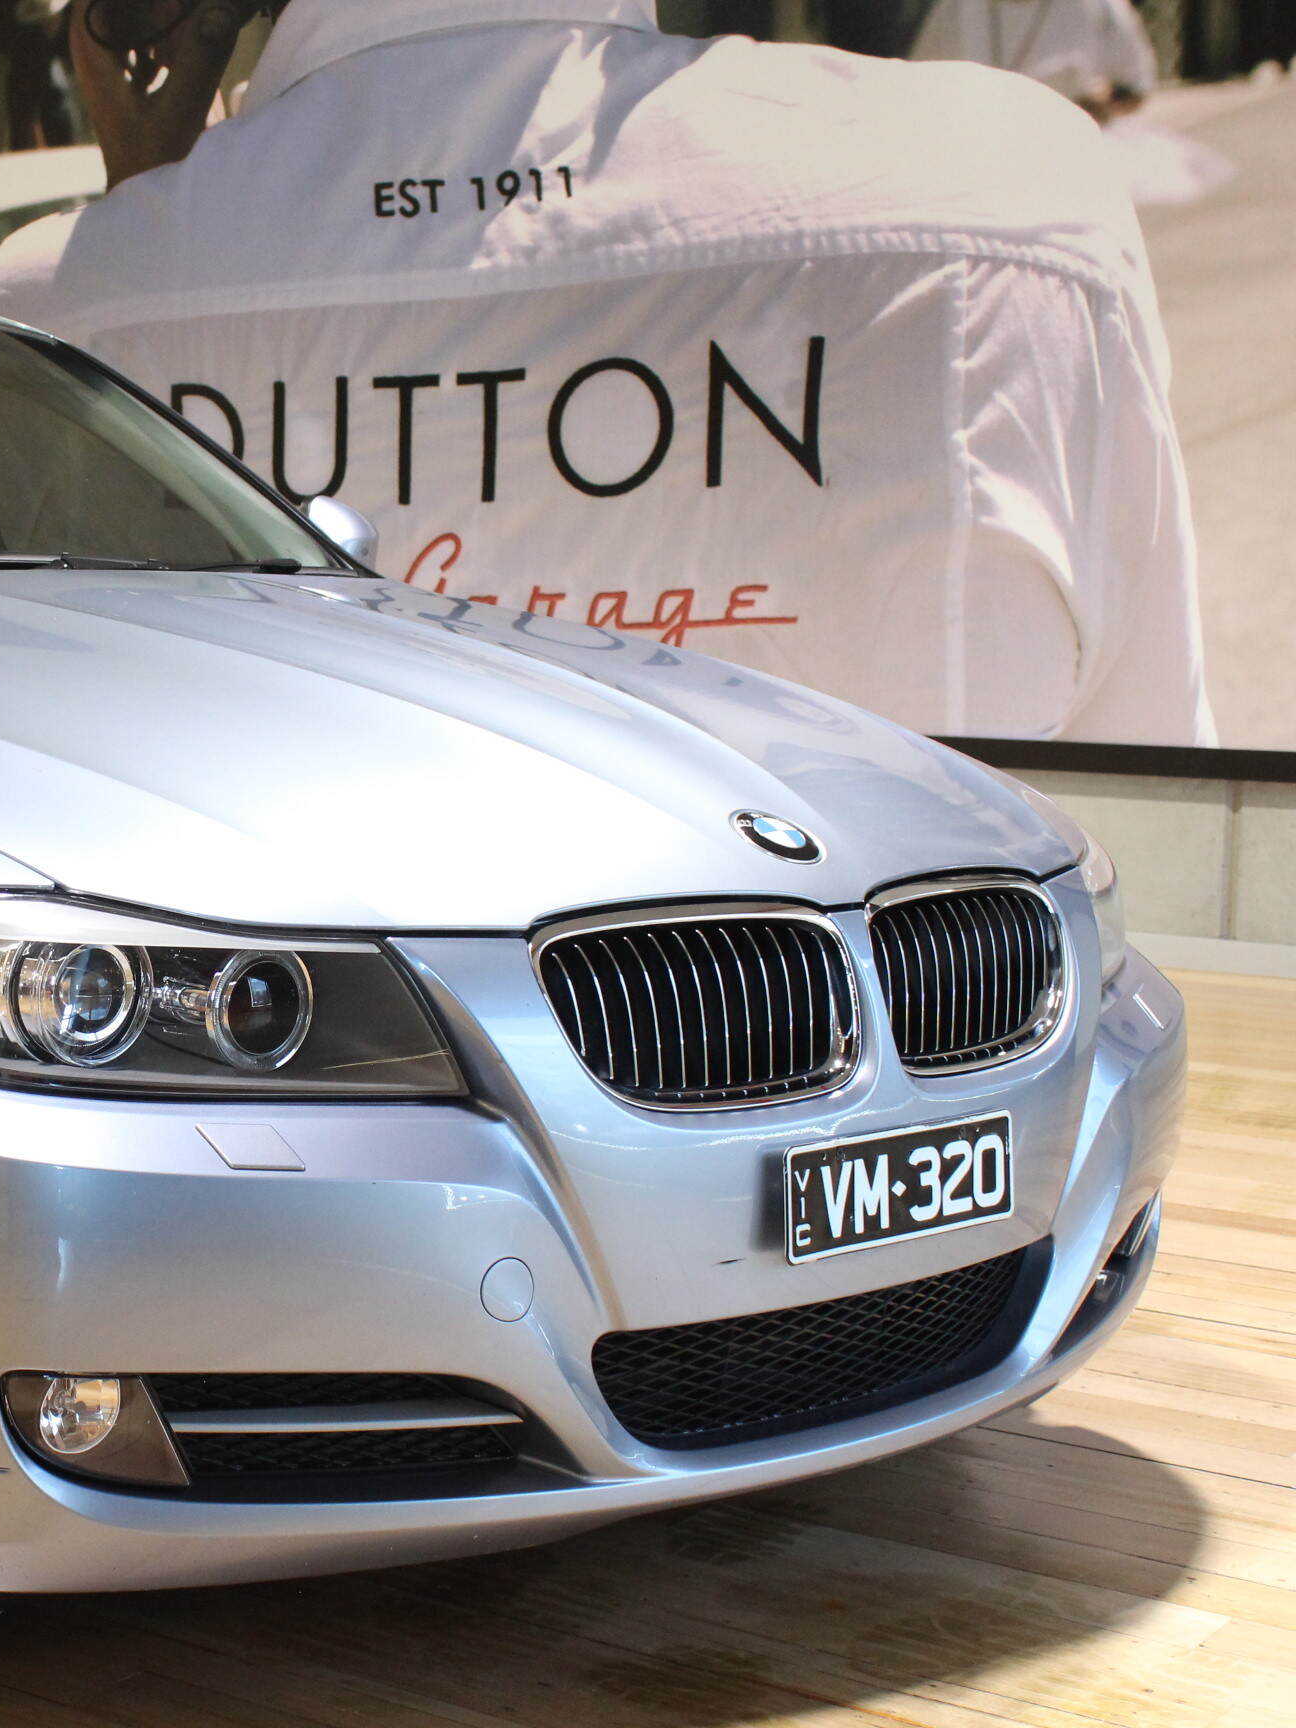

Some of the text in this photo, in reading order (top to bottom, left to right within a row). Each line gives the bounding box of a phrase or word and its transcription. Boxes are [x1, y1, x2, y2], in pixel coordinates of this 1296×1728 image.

[373, 165, 573, 218] EST 1911
[404, 532, 798, 648] Grage
[794, 1168, 811, 1247] VIC
